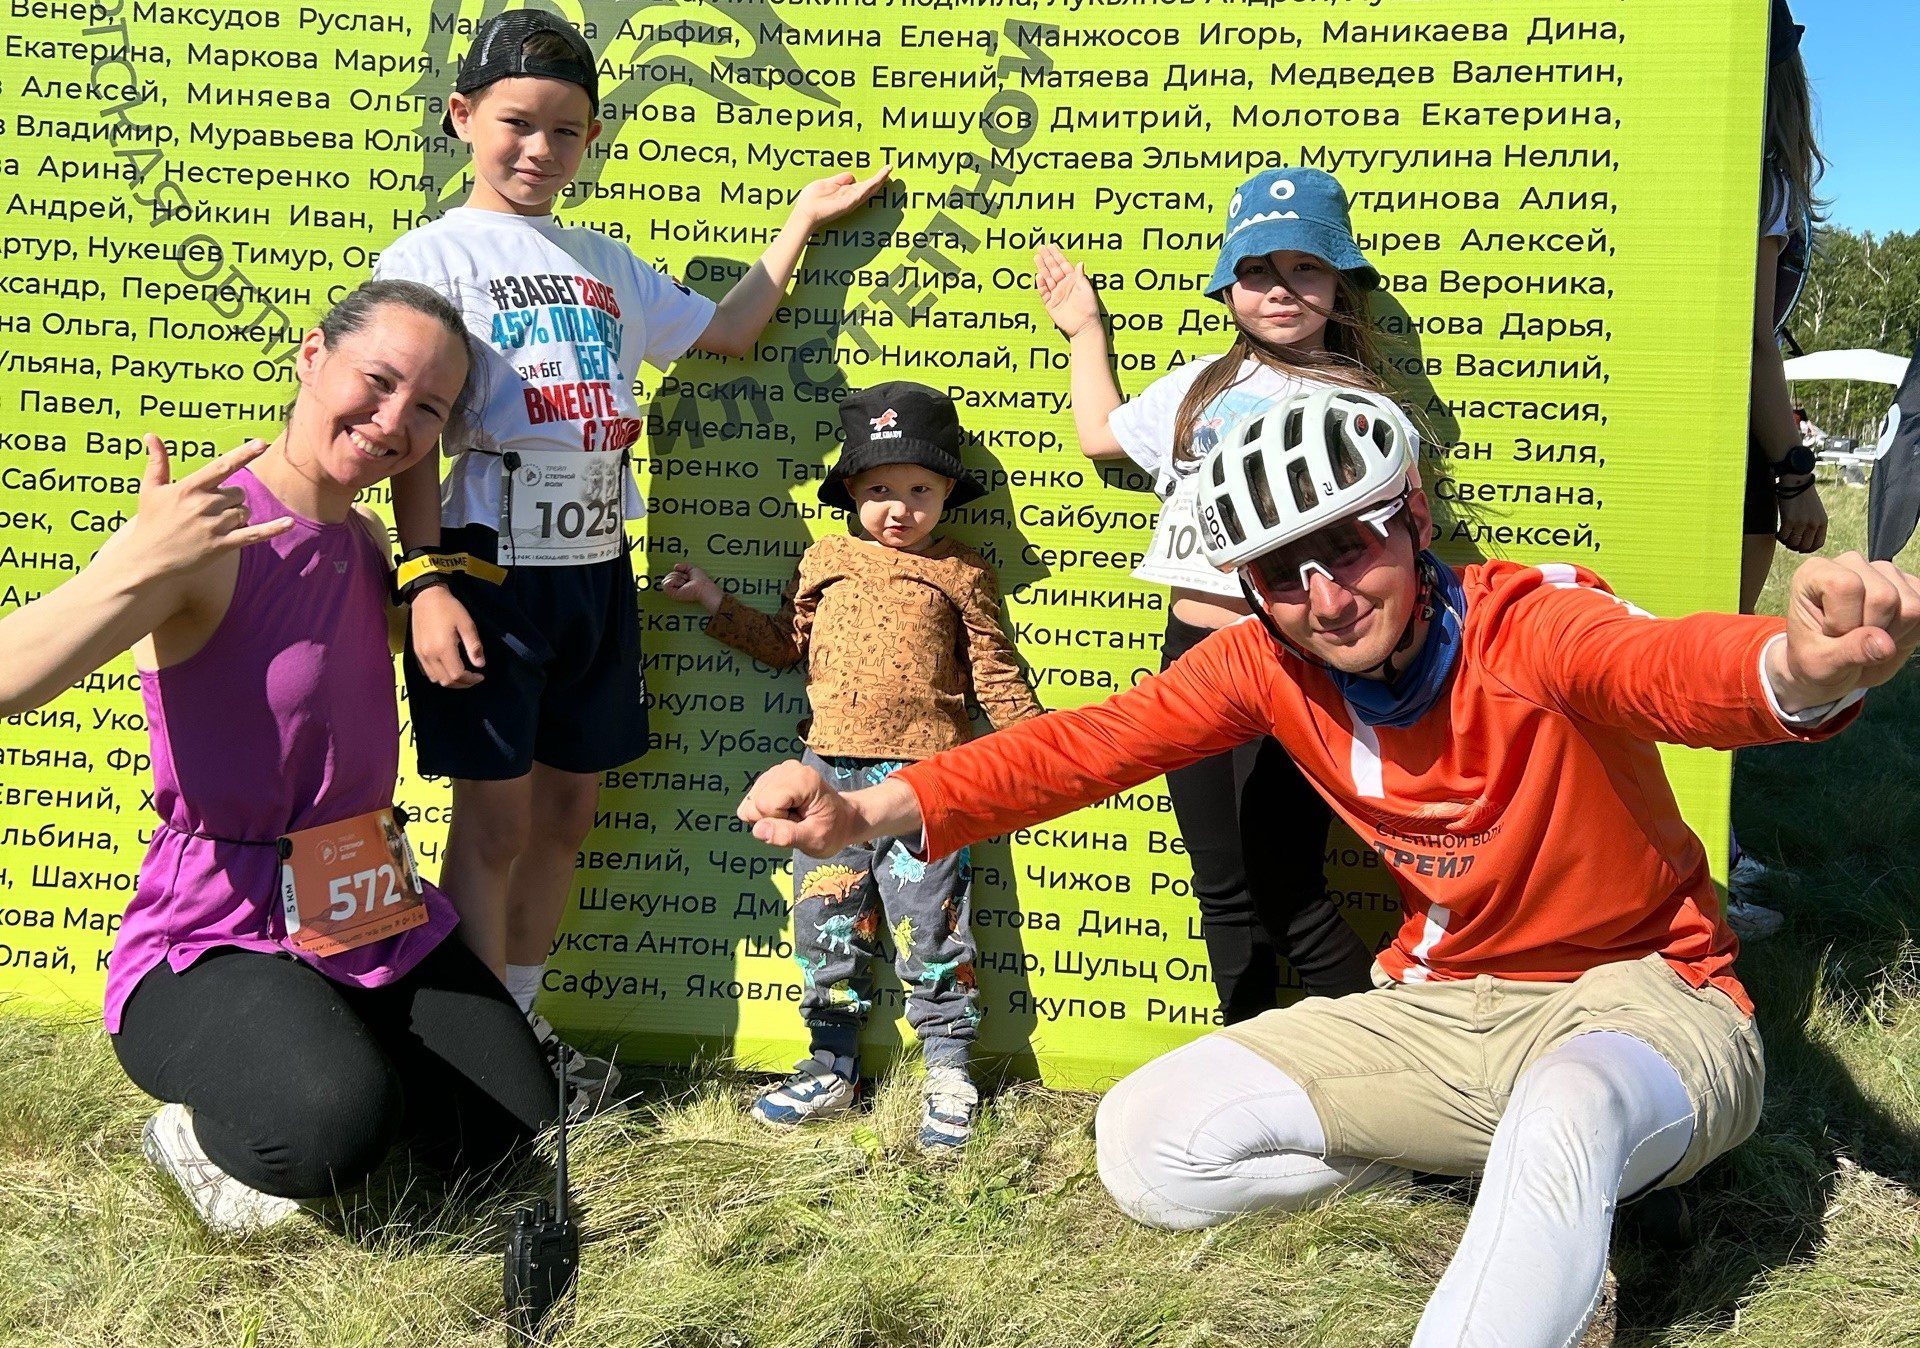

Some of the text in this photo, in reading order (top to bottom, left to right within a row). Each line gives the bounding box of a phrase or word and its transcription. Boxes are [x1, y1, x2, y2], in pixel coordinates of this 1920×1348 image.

[11, 0, 1625, 57] Венер, Максудов Руслан, Альфия, Мамина Елена, Манжосов Игорь, Маникаева Дина,
[6, 34, 1623, 96] Екатерина, Маркова Мария, Антон, Матросов Евгений, Матяева Дина, Медведев Валентин,
[20, 70, 167, 112] Алексей,
[187, 82, 330, 110] Миняева
[716, 96, 863, 133] Валерия,
[882, 106, 1033, 140] Мишуков
[1050, 103, 1211, 134] Дмитрий,
[1232, 104, 1400, 128] Молотова
[1422, 102, 1621, 131] Екатерина,
[16, 109, 179, 148] Владимир,
[190, 121, 353, 151] Муравьева
[365, 128, 456, 158] Юлия,
[638, 139, 737, 169] Олеся,
[747, 142, 871, 172] Мустаев
[879, 146, 980, 175] Тимур,
[990, 146, 1133, 178] Мустаева
[1300, 145, 1492, 174] Мутугулина
[1504, 144, 1619, 172] Нелли,
[37, 155, 145, 185] Арина,
[164, 159, 350, 189] Нестеренко
[369, 168, 443, 201] Юля,
[562, 180, 701, 204] атьянова
[864, 181, 1075, 220] Нигматуллин
[1095, 187, 1213, 216] Рустам,
[1349, 190, 1499, 213] утдинова
[1518, 186, 1617, 215] Алия,
[5, 193, 133, 224] Андрей,
[151, 198, 270, 225] Нойкин
[290, 204, 373, 234] Иван,
[650, 218, 782, 245] Нойкина
[986, 226, 1123, 251] Нойкина
[1357, 232, 1441, 256] ырев
[1459, 227, 1616, 257] Алексей,
[0, 236, 77, 261] ртур,
[88, 233, 224, 264] Нукешев
[231, 241, 333, 272] Тимур,
[897, 262, 983, 297] Лира,
[1440, 269, 1614, 300] Вероника,
[0, 276, 106, 302] сандр,
[122, 271, 311, 311] Перепелкин
[775, 307, 893, 331] ершина
[910, 301, 1037, 334] Наталья,
[1499, 312, 1612, 342] Дарья,
[491, 308, 549, 350] 45%
[42, 312, 137, 342] Ольга,
[880, 344, 1018, 374] Николай,
[1456, 353, 1610, 384] Василий,
[111, 354, 245, 384] Ракутько
[656, 376, 784, 407] Раскина
[948, 386, 1071, 415] Рахмату
[1425, 397, 1608, 426] Анастасия,
[523, 381, 619, 425] ВМЕСТЕ
[20, 389, 121, 420] Павел,
[646, 409, 796, 450] Вячеслав,
[1512, 437, 1605, 469] Зиля,
[87, 432, 222, 461] Варара,
[633, 456, 758, 481] таренко
[1434, 476, 1603, 509] Светлана,
[1, 467, 141, 495] Сабитова
[647, 496, 750, 517] зонова
[1450, 519, 1601, 552] Алексей,
[536, 498, 618, 539] 1025
[1166, 524, 1203, 560] 10
[0, 546, 1163, 611] Анна, Слинкина
[642, 650, 739, 676] итрий,
[1015, 621, 1163, 651] Констант
[599, 768, 730, 797] ветлана,
[1, 824, 119, 855] льбина,
[576, 846, 691, 875] авелий,
[1026, 864, 1131, 893] Чижов
[1374, 840, 1475, 879] ТРЕЙЛ
[329, 863, 402, 921] 572
[579, 886, 717, 918] Шекунов
[1077, 909, 1168, 942] Дина,
[548, 931, 629, 956] укста
[634, 930, 736, 962] Антон,
[1054, 950, 1158, 984] Шульц
[541, 968, 667, 1001] Сафуан,
[686, 972, 802, 1002] Яковле
[1008, 990, 1126, 1028] Якупов
